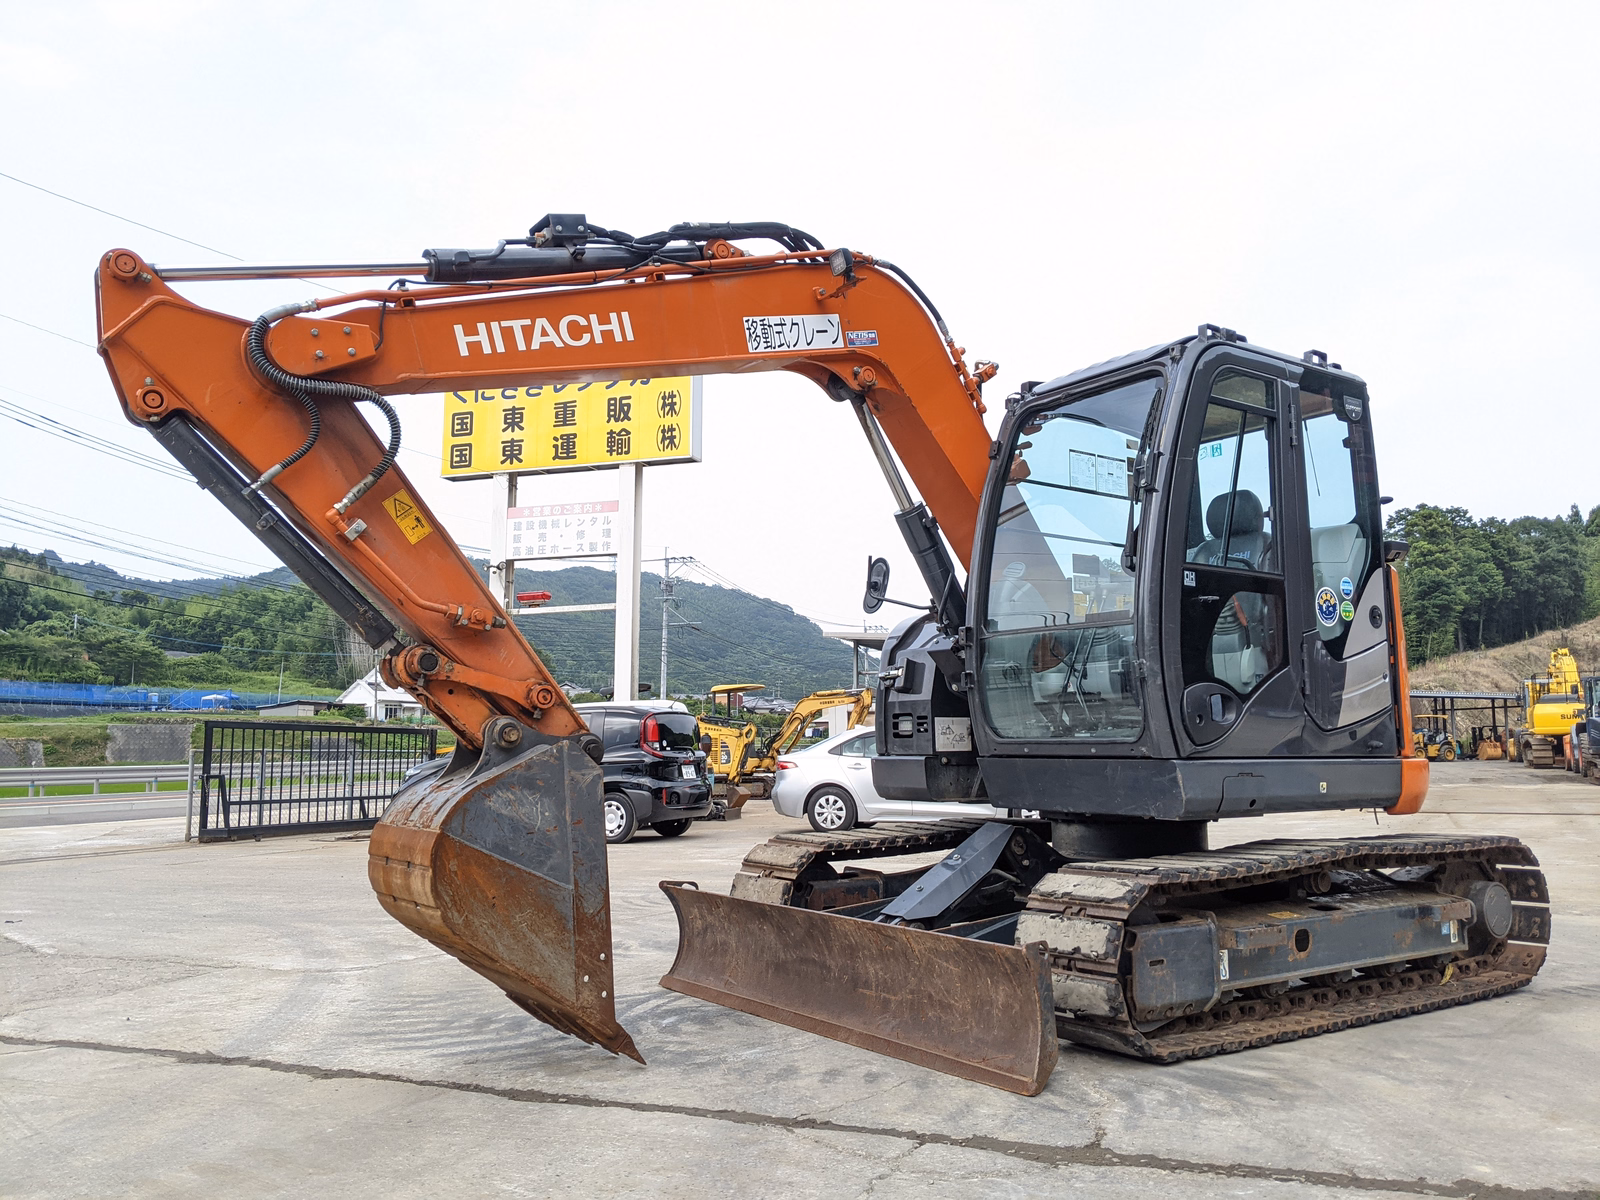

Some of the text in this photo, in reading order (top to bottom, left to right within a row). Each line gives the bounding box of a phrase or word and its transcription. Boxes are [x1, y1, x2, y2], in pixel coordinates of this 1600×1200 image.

[453, 311, 635, 357] HITACHI
[744, 317, 840, 351] 移動式クレーン
[513, 516, 612, 532] 建設機械レンタル
[512, 541, 612, 557] 高油圧ホース製作
